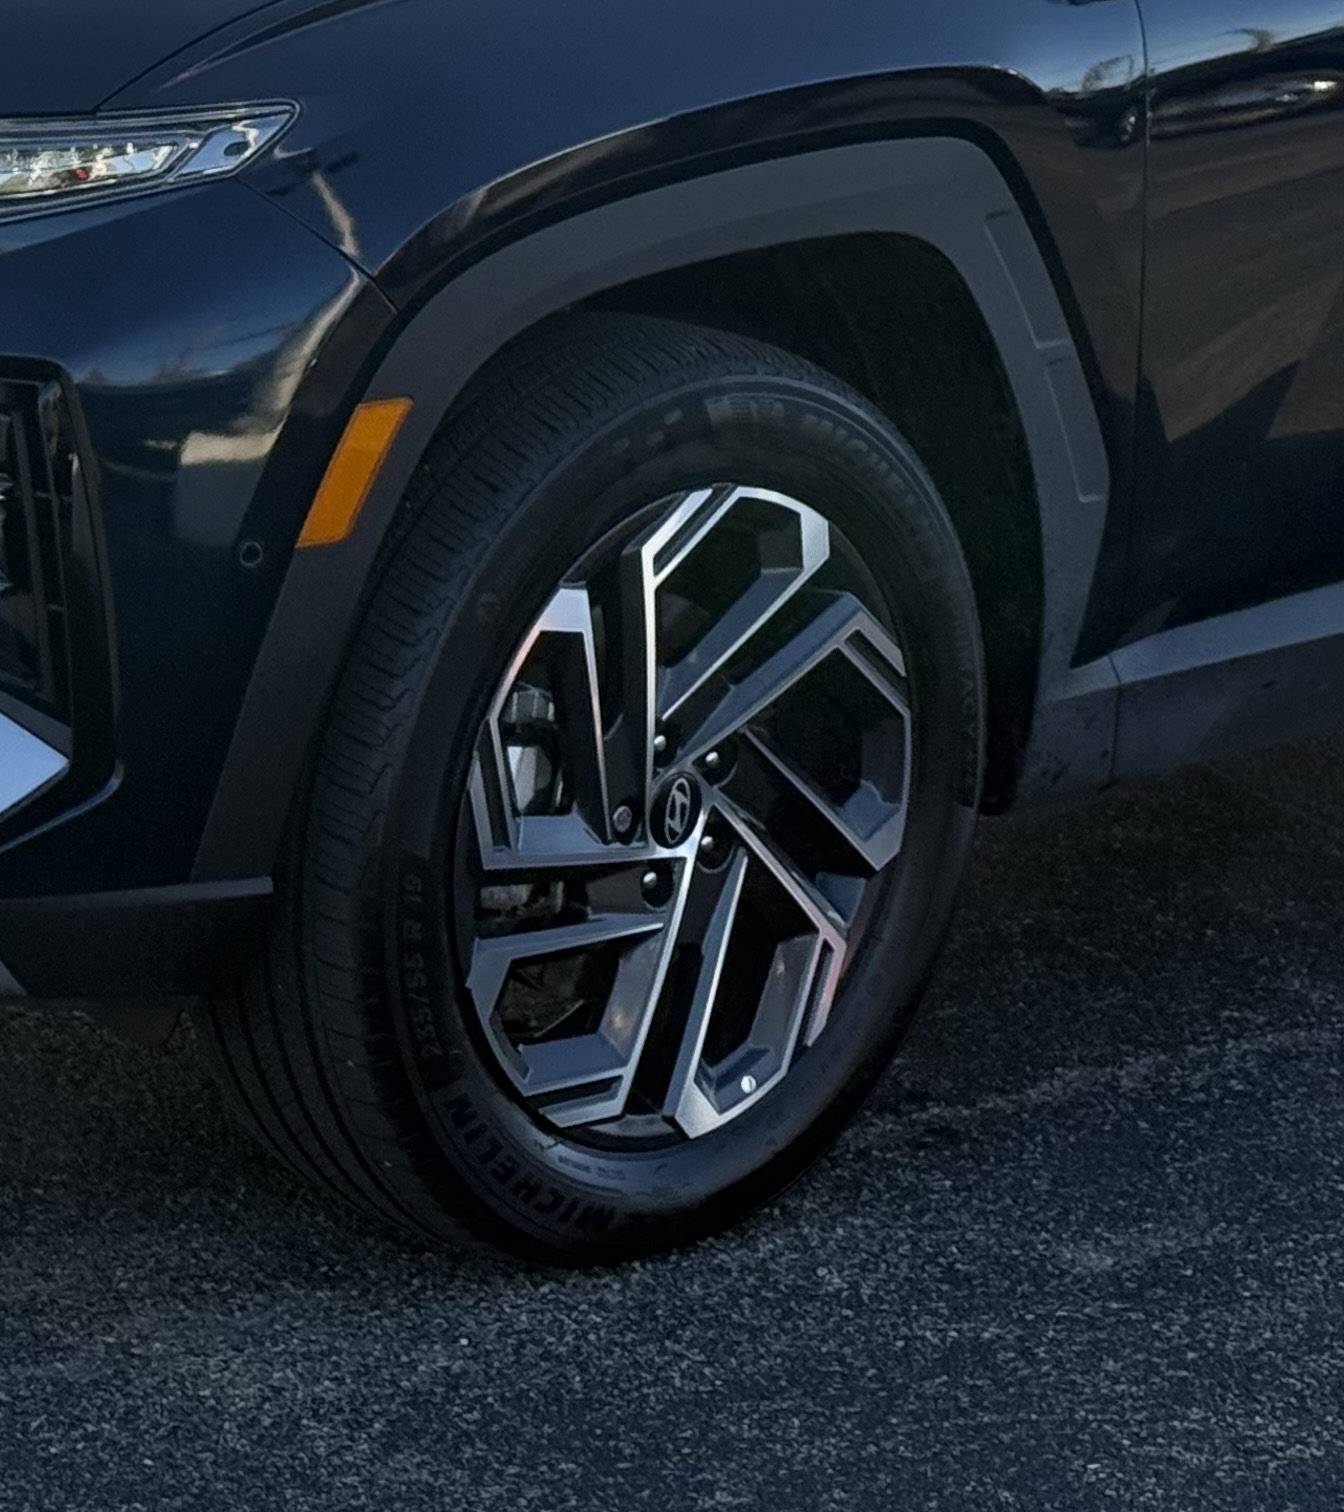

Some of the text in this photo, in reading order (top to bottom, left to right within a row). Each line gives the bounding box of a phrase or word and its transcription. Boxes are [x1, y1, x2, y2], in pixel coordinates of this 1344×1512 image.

[402, 873, 443, 1059] 235/55 R 19
[445, 1092, 616, 1233] MICHELIN
